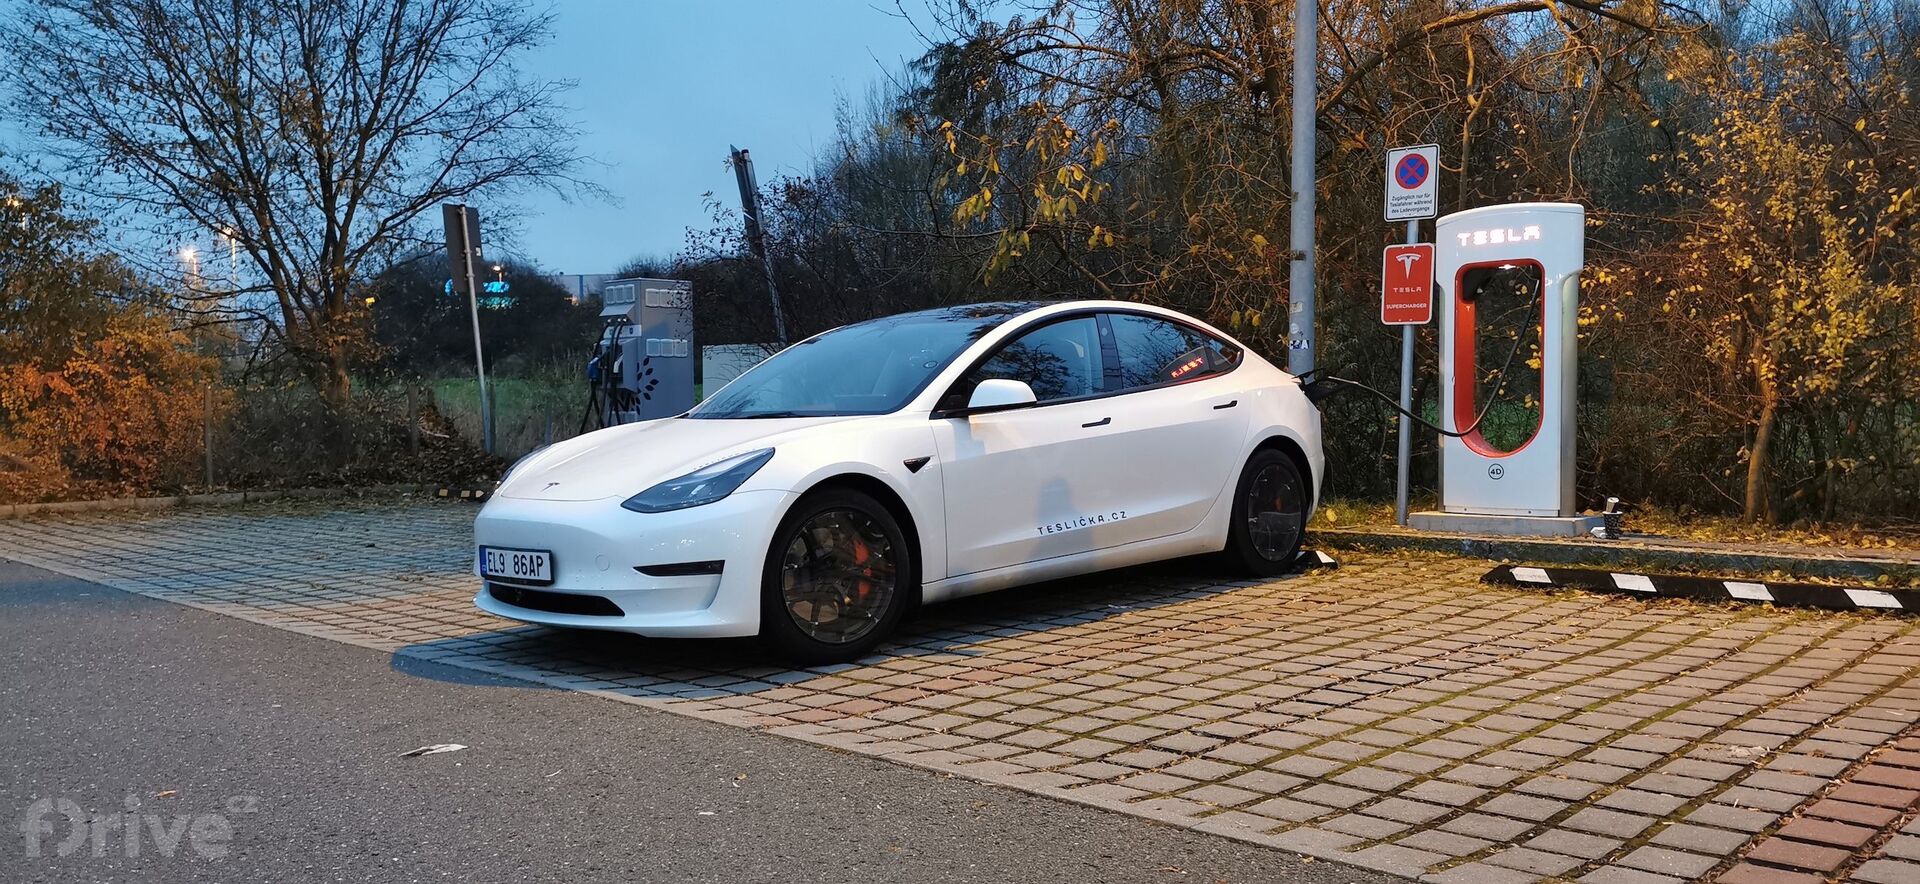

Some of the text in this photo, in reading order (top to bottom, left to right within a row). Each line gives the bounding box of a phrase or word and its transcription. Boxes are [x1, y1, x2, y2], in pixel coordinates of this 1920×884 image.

[1457, 226, 1540, 247] TESLA
[1037, 511, 1127, 535] TESLIČKA.CZ
[488, 552, 505, 573] EL9
[513, 554, 543, 576] 86AP
